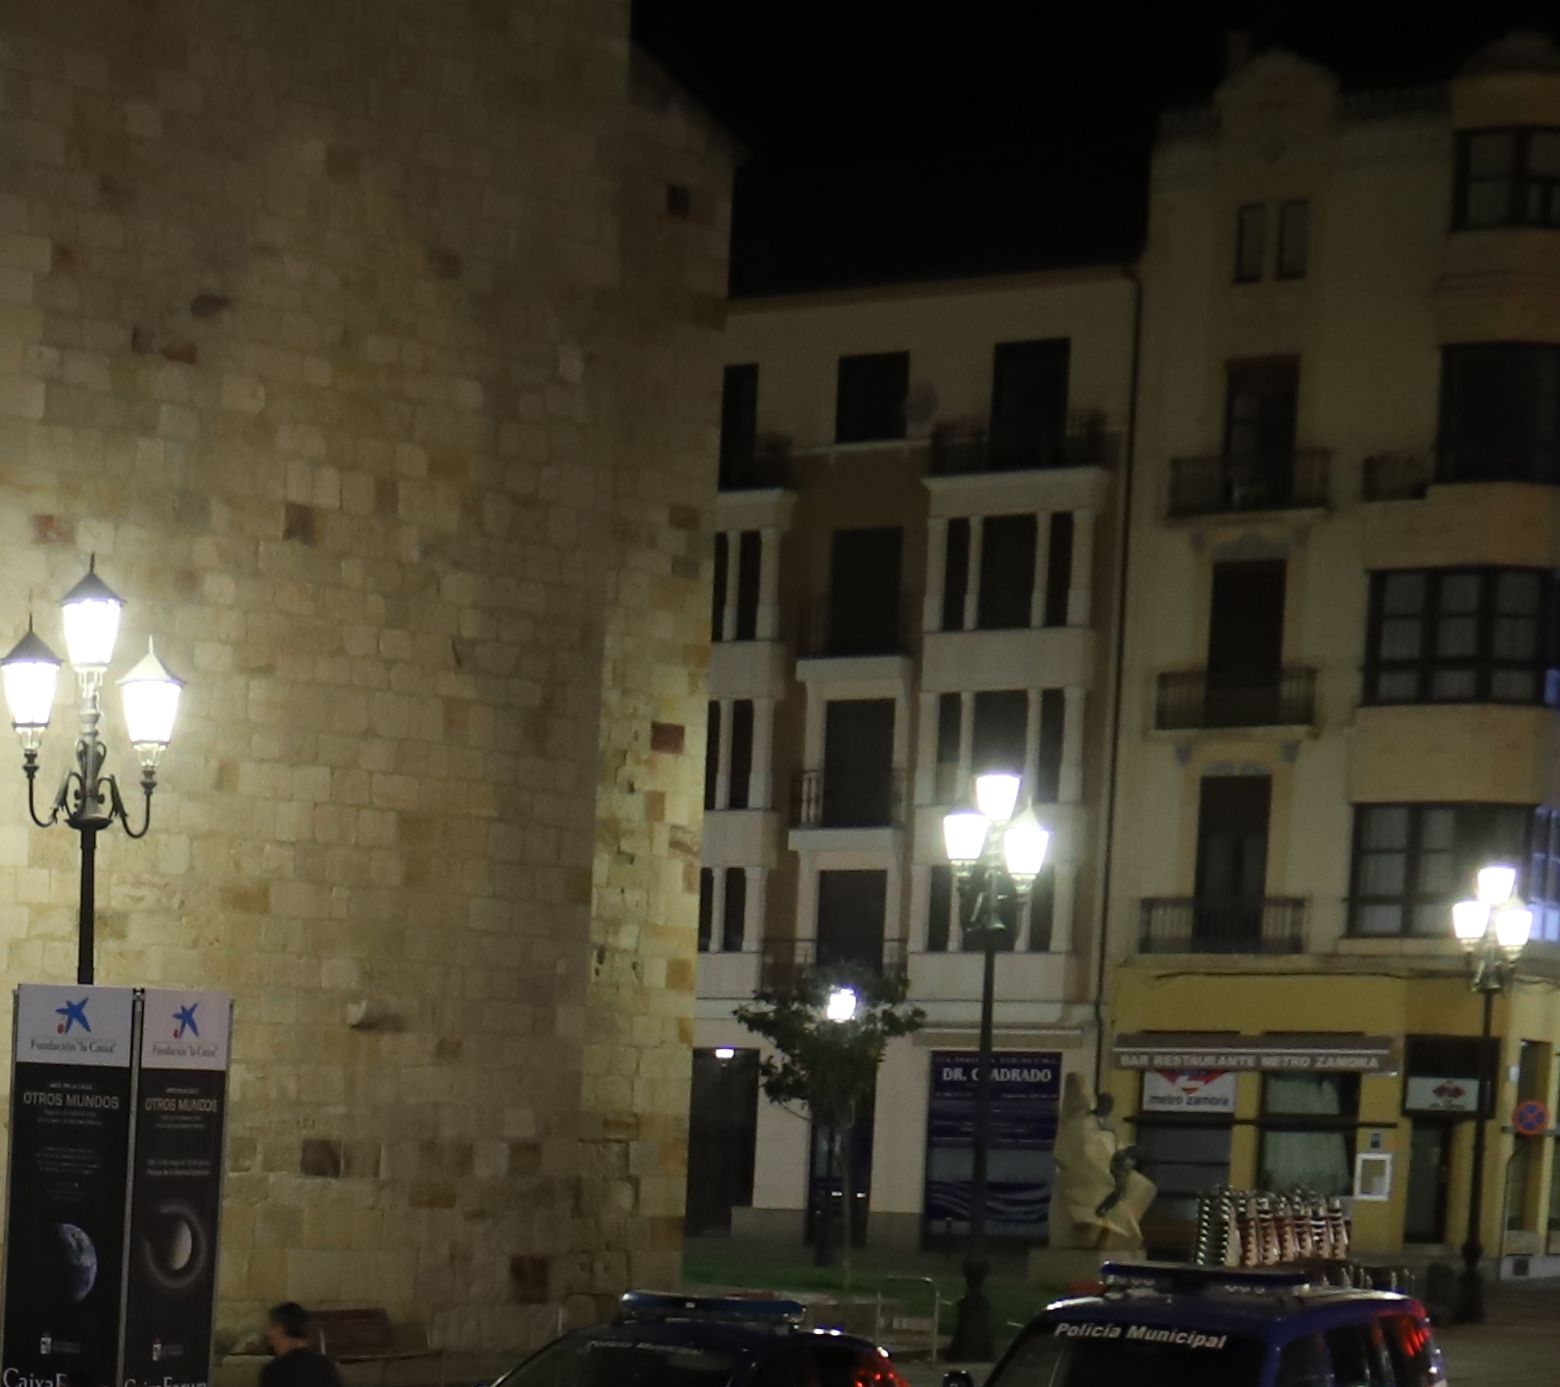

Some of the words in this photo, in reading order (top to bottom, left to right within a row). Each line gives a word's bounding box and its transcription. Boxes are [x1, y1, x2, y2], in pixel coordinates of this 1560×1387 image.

[1121, 1055, 1149, 1066] BAR
[1261, 1055, 1311, 1067] METRO
[1316, 1055, 1379, 1068] ZAMORA
[943, 1067, 967, 1081] DR.
[971, 1068, 1052, 1082] CADRADO
[23, 1092, 63, 1107] OTROS
[65, 1092, 119, 1110] MUNDOS
[145, 1097, 175, 1111] OTROS
[177, 1098, 217, 1113] MUNDOS
[1186, 1096, 1230, 1106] zamora
[1126, 1325, 1228, 1349] Municipal
